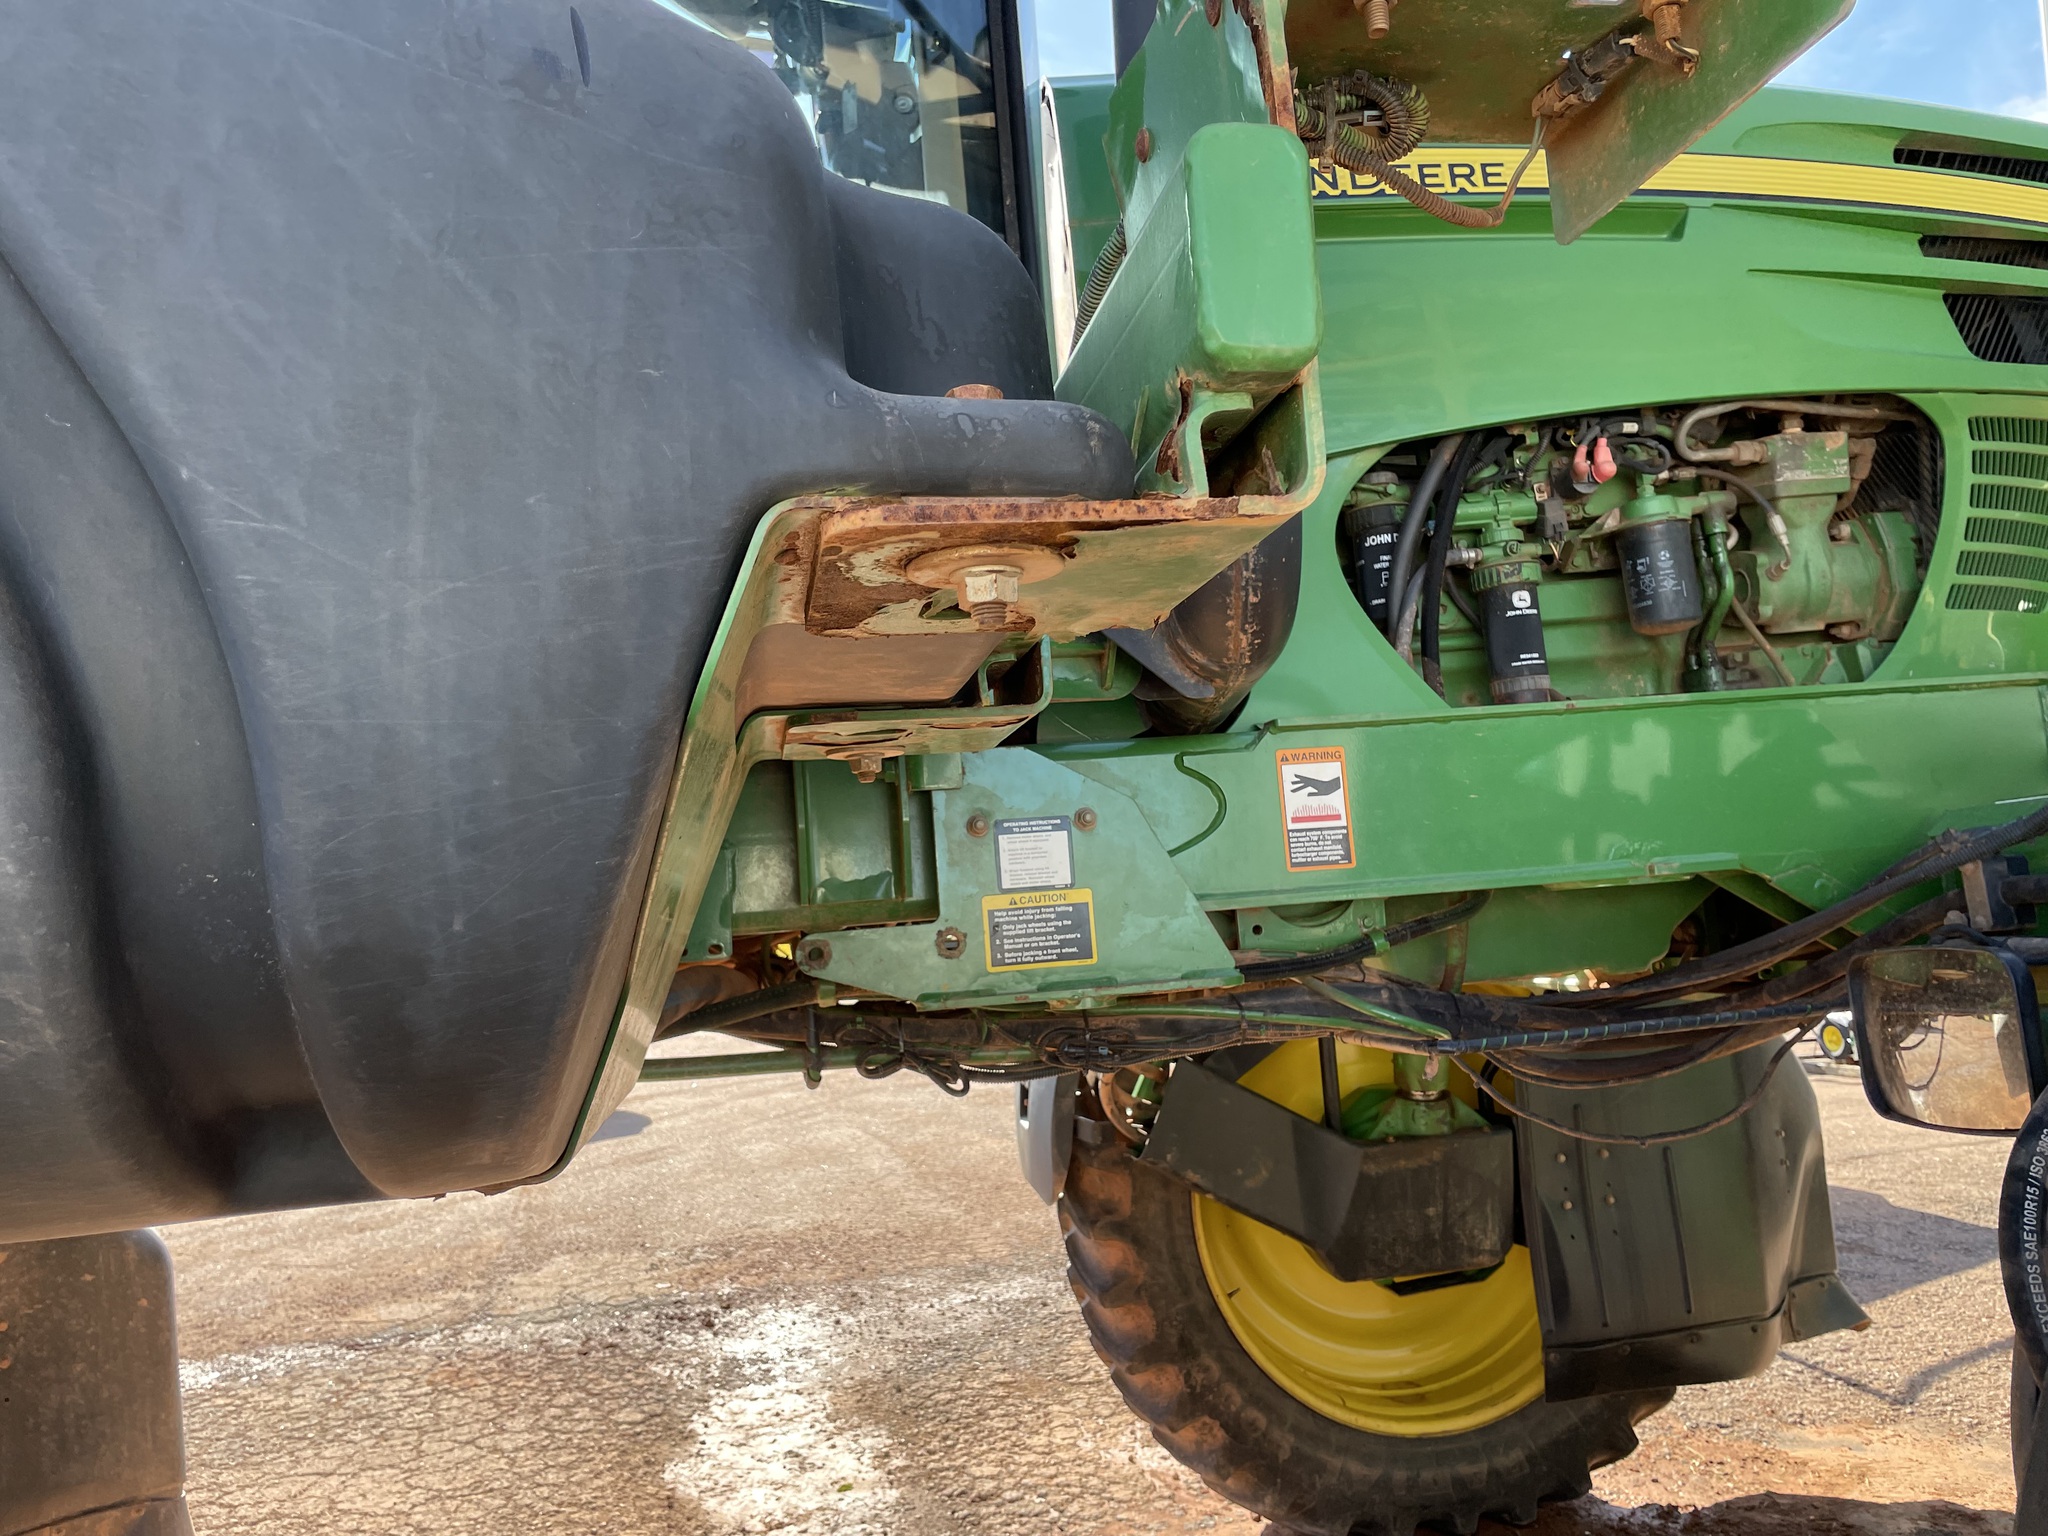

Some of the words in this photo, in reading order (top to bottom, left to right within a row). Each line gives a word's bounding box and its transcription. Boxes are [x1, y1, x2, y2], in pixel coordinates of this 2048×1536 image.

[1350, 162, 1508, 190] DERE
[1364, 533, 1392, 547] JOHN
[1291, 751, 1342, 761] WARNING
[1019, 893, 1066, 904] CAUTION
[2029, 1156, 2046, 1178] ISO
[2023, 1185, 2040, 1260] SAE100R15
